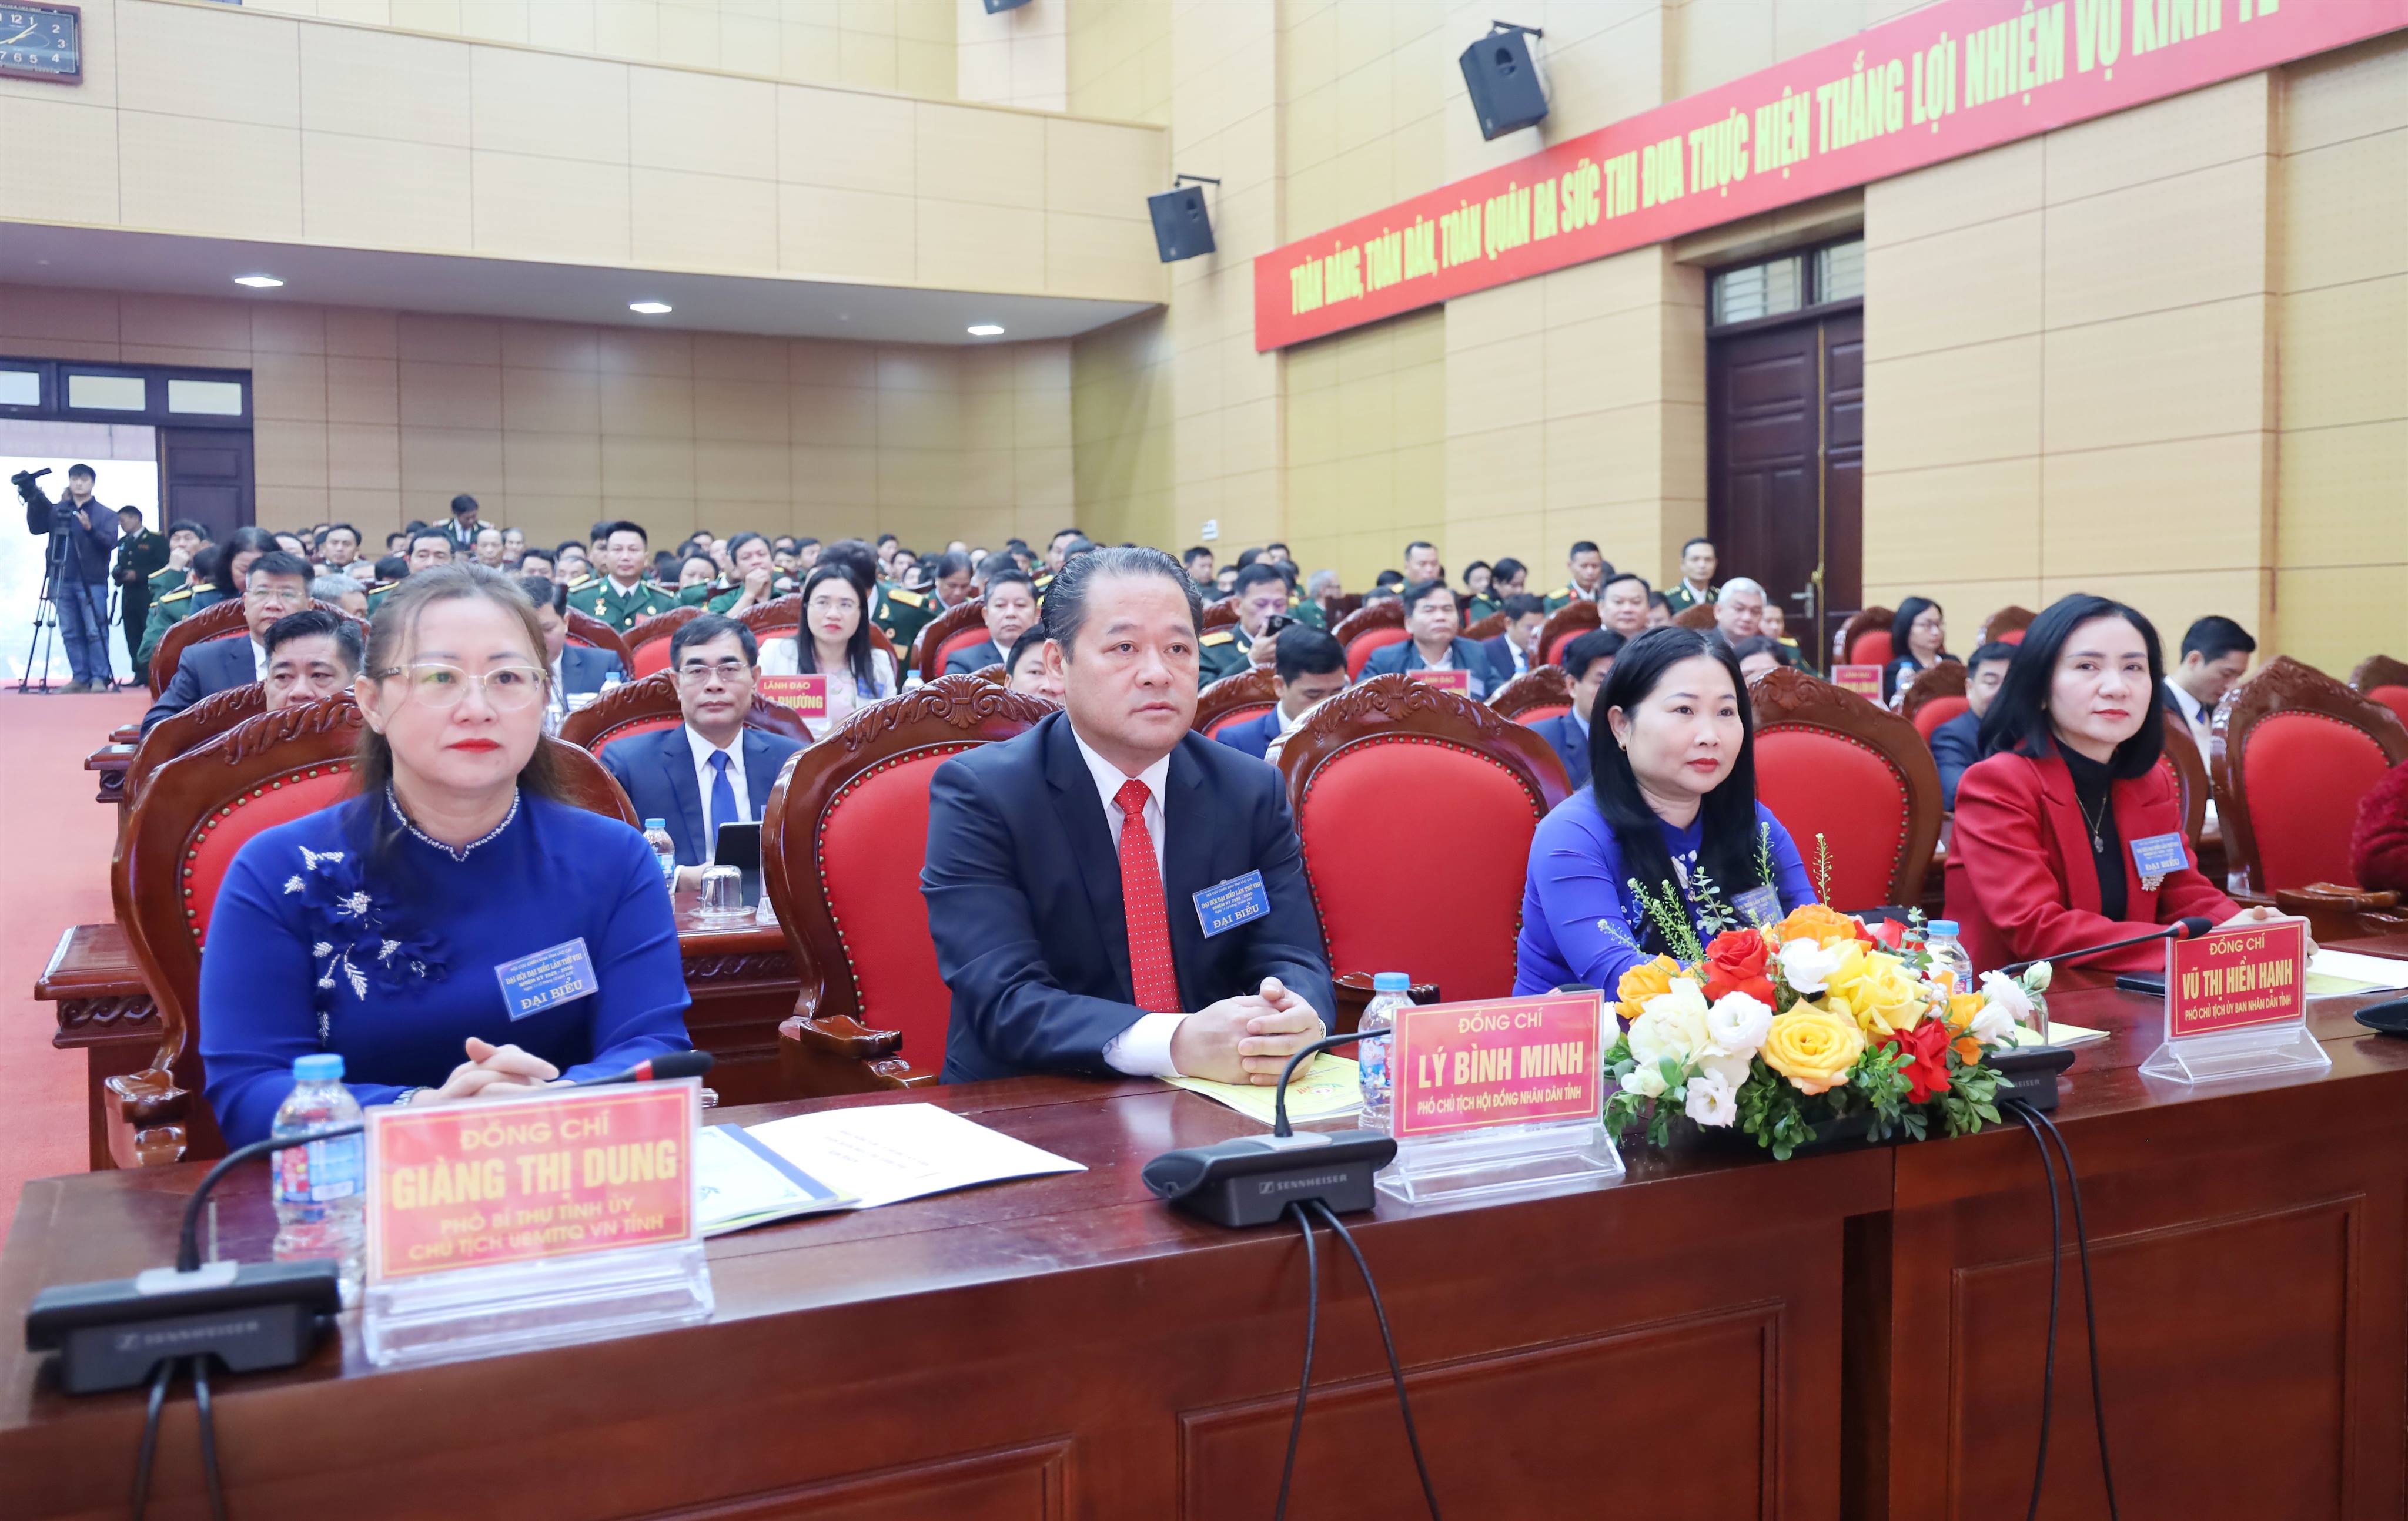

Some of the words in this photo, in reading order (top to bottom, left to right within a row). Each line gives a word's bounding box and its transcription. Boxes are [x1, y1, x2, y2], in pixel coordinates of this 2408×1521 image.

[11, 14, 22, 24] 12
[29, 16, 34, 25] 1
[52, 24, 61, 33] 2
[58, 39, 65, 48] 3
[14, 53, 22, 62] 6
[29, 54, 38, 63] 5
[51, 53, 59, 62] 4
[1440, 199, 1481, 269] TOÀN
[1484, 181, 1530, 260] QUÂN
[1534, 178, 1558, 242] RA
[1561, 157, 1600, 233] SỨC
[1604, 150, 1638, 220] THI
[1641, 136, 1684, 209] ĐUA
[1689, 107, 1749, 198] THỰC
[1754, 85, 1810, 179] HIỆN
[1817, 50, 1904, 154] THẮNG
[1912, 31, 1956, 133] LỢI
[1965, 0, 2065, 108] NHIỆM
[2075, 0, 2122, 81] VỤ
[764, 681, 787, 689] LÃNH
[790, 681, 810, 691] ĐẠO
[1212, 914, 1233, 929] ĐẠI
[1235, 902, 1259, 920] BIỂU
[2209, 937, 2243, 955] ĐỒNG
[2246, 932, 2266, 950] CHÍ
[2182, 967, 2199, 1000] VŨ
[2203, 969, 2223, 1001] THỊ
[2226, 956, 2255, 993] HIỀN
[2259, 959, 2292, 993] HẠNH
[520, 992, 548, 1010] ĐẠI
[549, 977, 584, 999] BIỂU
[2185, 1006, 2198, 1020] PHÓ
[2199, 1003, 2211, 1019] CHỦ
[2212, 1004, 2225, 1019] TỊCH
[2226, 1000, 2235, 1014] ỦY
[2235, 1001, 2248, 1013] BAN
[2248, 997, 2265, 1011] NHÂN
[2266, 994, 2278, 1008] DÂN
[2279, 991, 2292, 1006] TỈNH
[1458, 1010, 1510, 1034] ĐỒNG
[1514, 1007, 1543, 1028] CHÍ
[1418, 1046, 1447, 1089] LÝ
[1454, 1043, 1512, 1085] BÌNH
[1520, 1041, 1584, 1079] MINH
[1417, 1096, 1435, 1115] PHÓ
[1437, 1094, 1454, 1113] CHỦ
[1456, 1094, 1474, 1114] TỊCH
[1476, 1091, 1491, 1111] HỘI
[1493, 1087, 1519, 1107] ĐỒNG
[1520, 1087, 1544, 1104] NHÂN
[1545, 1086, 1563, 1101] DÂN
[1564, 1082, 1582, 1100] TỈNH
[460, 1119, 551, 1150] ĐỒNG
[560, 1110, 610, 1139] CHÍ
[392, 1157, 506, 1210] GIÀNG
[517, 1151, 571, 1200] THỊ
[583, 1139, 678, 1187] DUNG
[1277, 1174, 1347, 1191] SENNHEISER
[440, 1211, 486, 1235] PHÓ
[492, 1207, 510, 1228] BÍ
[517, 1205, 554, 1224] THƯ
[559, 1198, 603, 1220] TỈNH
[608, 1193, 635, 1213] ỦY
[409, 1237, 453, 1261] CHỦ
[459, 1234, 503, 1257] TỊCH
[589, 1219, 617, 1237] VN
[623, 1213, 664, 1233] TỈNH
